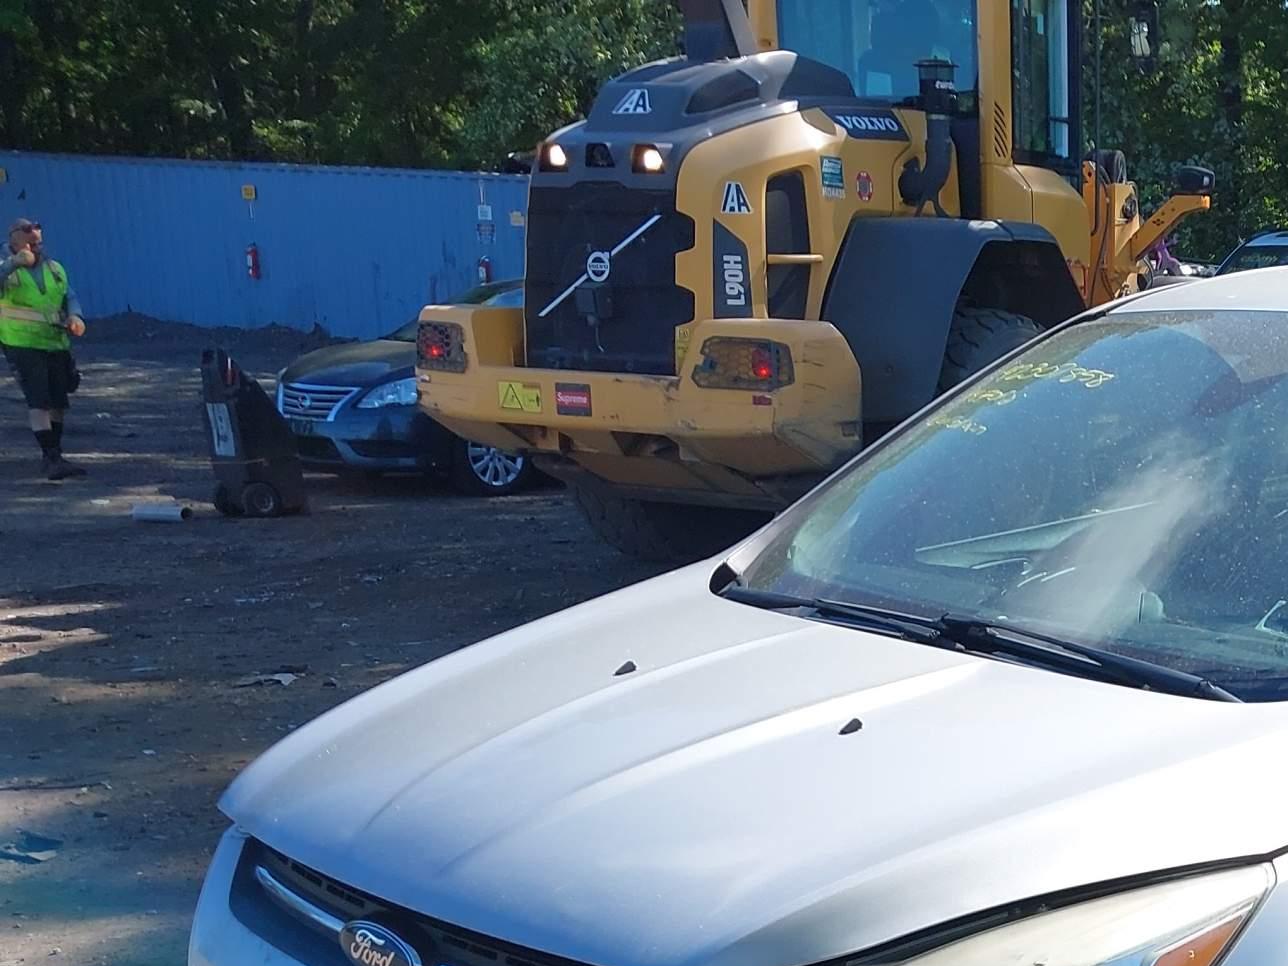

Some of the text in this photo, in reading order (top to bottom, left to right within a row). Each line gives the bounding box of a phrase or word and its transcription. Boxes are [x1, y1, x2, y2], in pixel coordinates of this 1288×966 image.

[835, 115, 899, 132] VOLVO
[723, 254, 746, 306] L90H
[556, 392, 588, 405] Supreme
